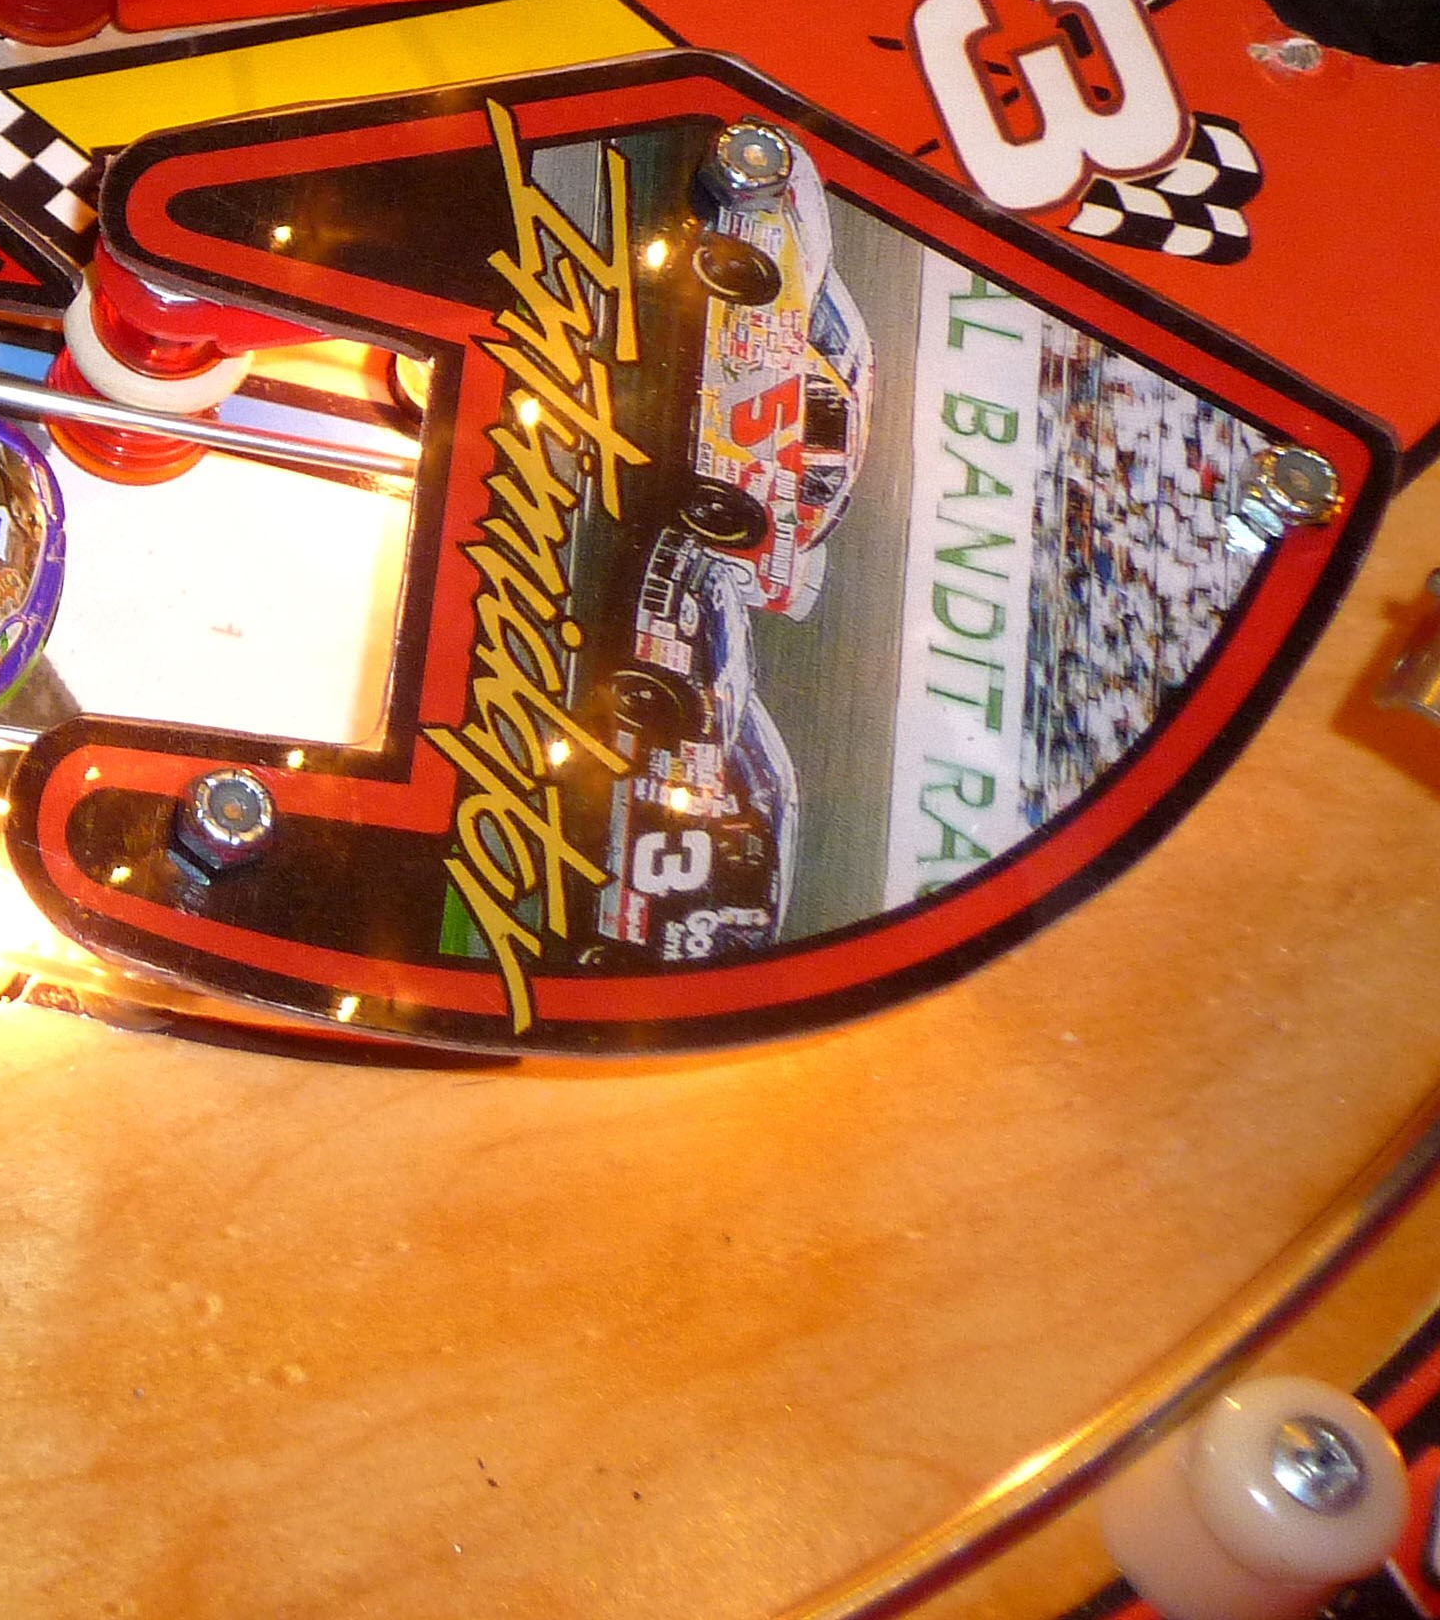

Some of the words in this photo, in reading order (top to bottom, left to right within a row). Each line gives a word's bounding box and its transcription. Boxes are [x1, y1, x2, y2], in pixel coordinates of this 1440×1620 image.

[730, 374, 803, 448] 5
[422, 97, 651, 1036] Intimidator
[927, 390, 1019, 735] BANDIT
[633, 829, 713, 894] 3
[914, 755, 996, 900] RA
